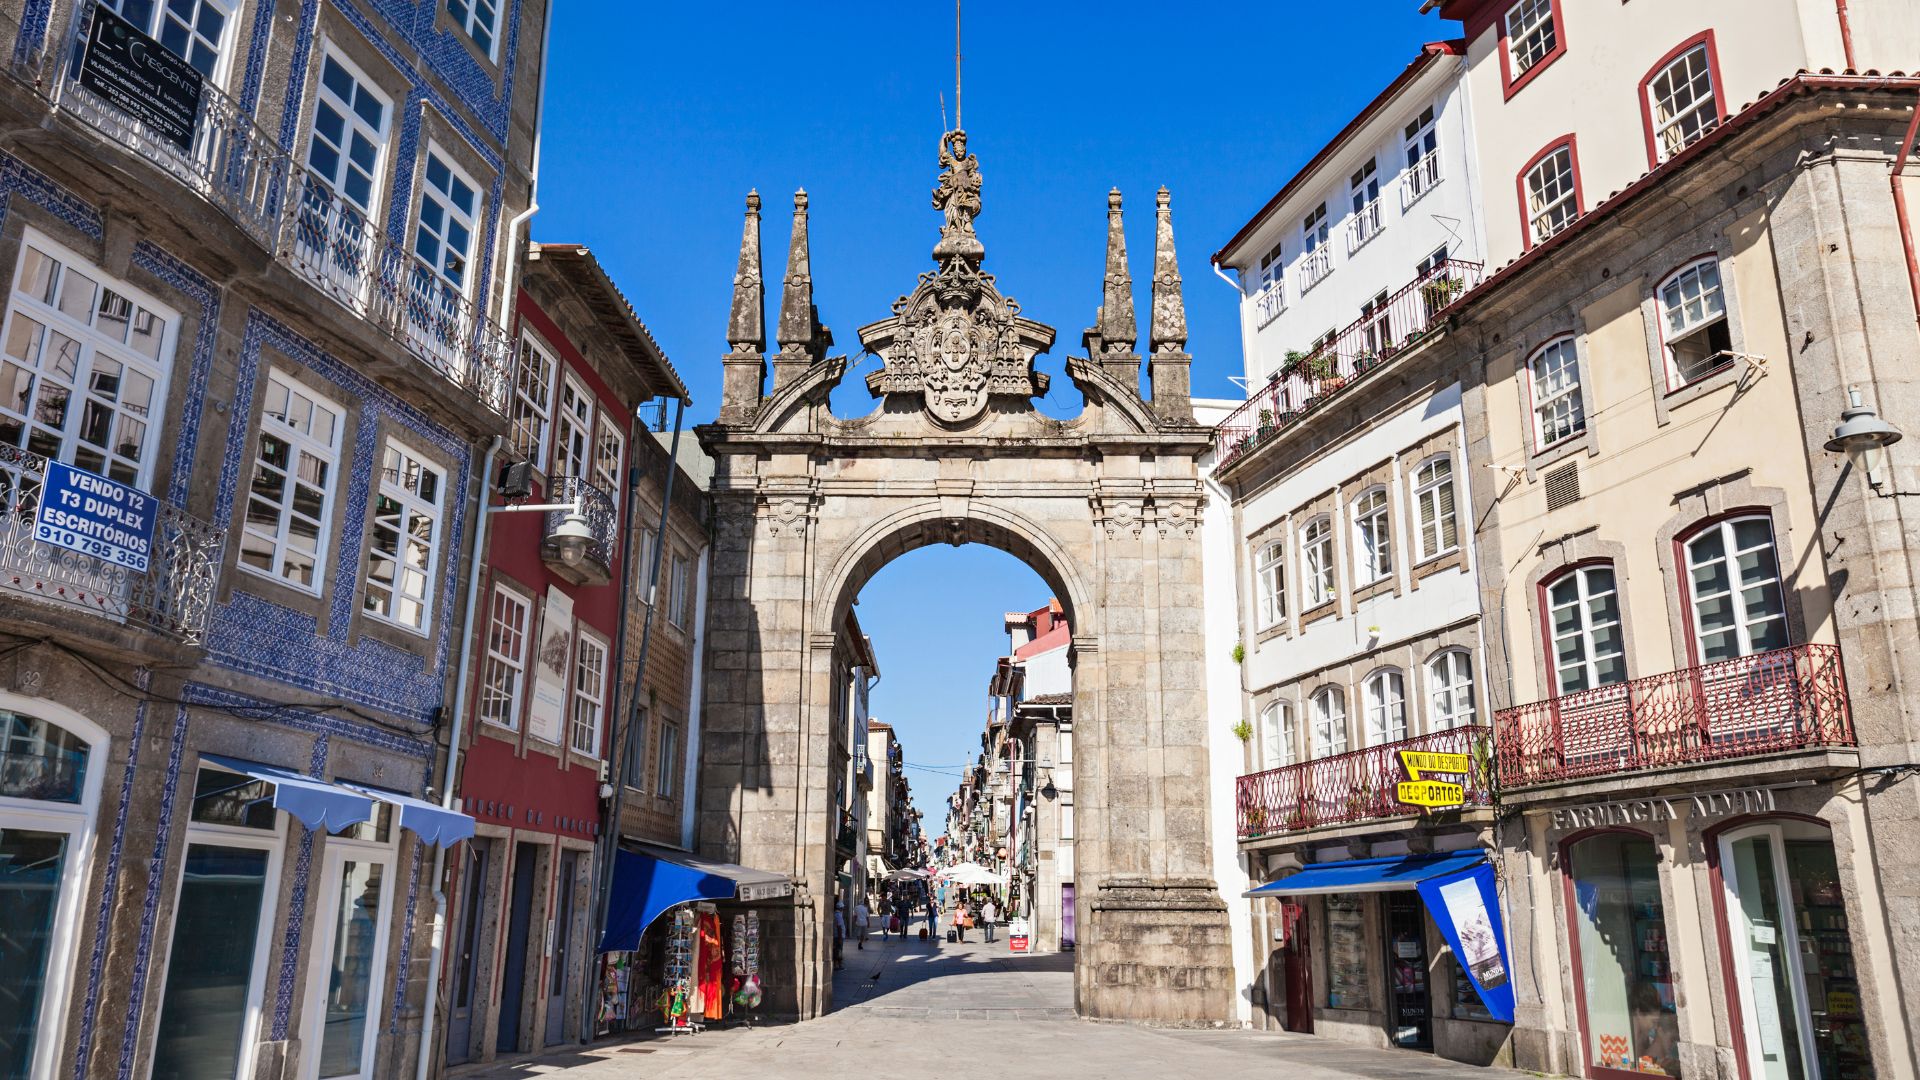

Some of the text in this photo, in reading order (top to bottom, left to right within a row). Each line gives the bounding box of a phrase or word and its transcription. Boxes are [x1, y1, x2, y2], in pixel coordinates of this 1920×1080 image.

[146, 116, 166, 134] BRAGA
[69, 471, 144, 511] VENDO T2
[60, 489, 144, 531] T3 DUPLEX
[39, 526, 146, 569] 910 795 356
[43, 507, 148, 553] ESCRITÓRIOS
[23, 671, 41, 688] 32
[1406, 754, 1467, 770] MUNDO DO DESPORTO
[1399, 784, 1461, 801] DESPORTOS
[1690, 788, 1776, 818] ALVIM
[465, 796, 599, 836] MUSEU DA IMAGEM
